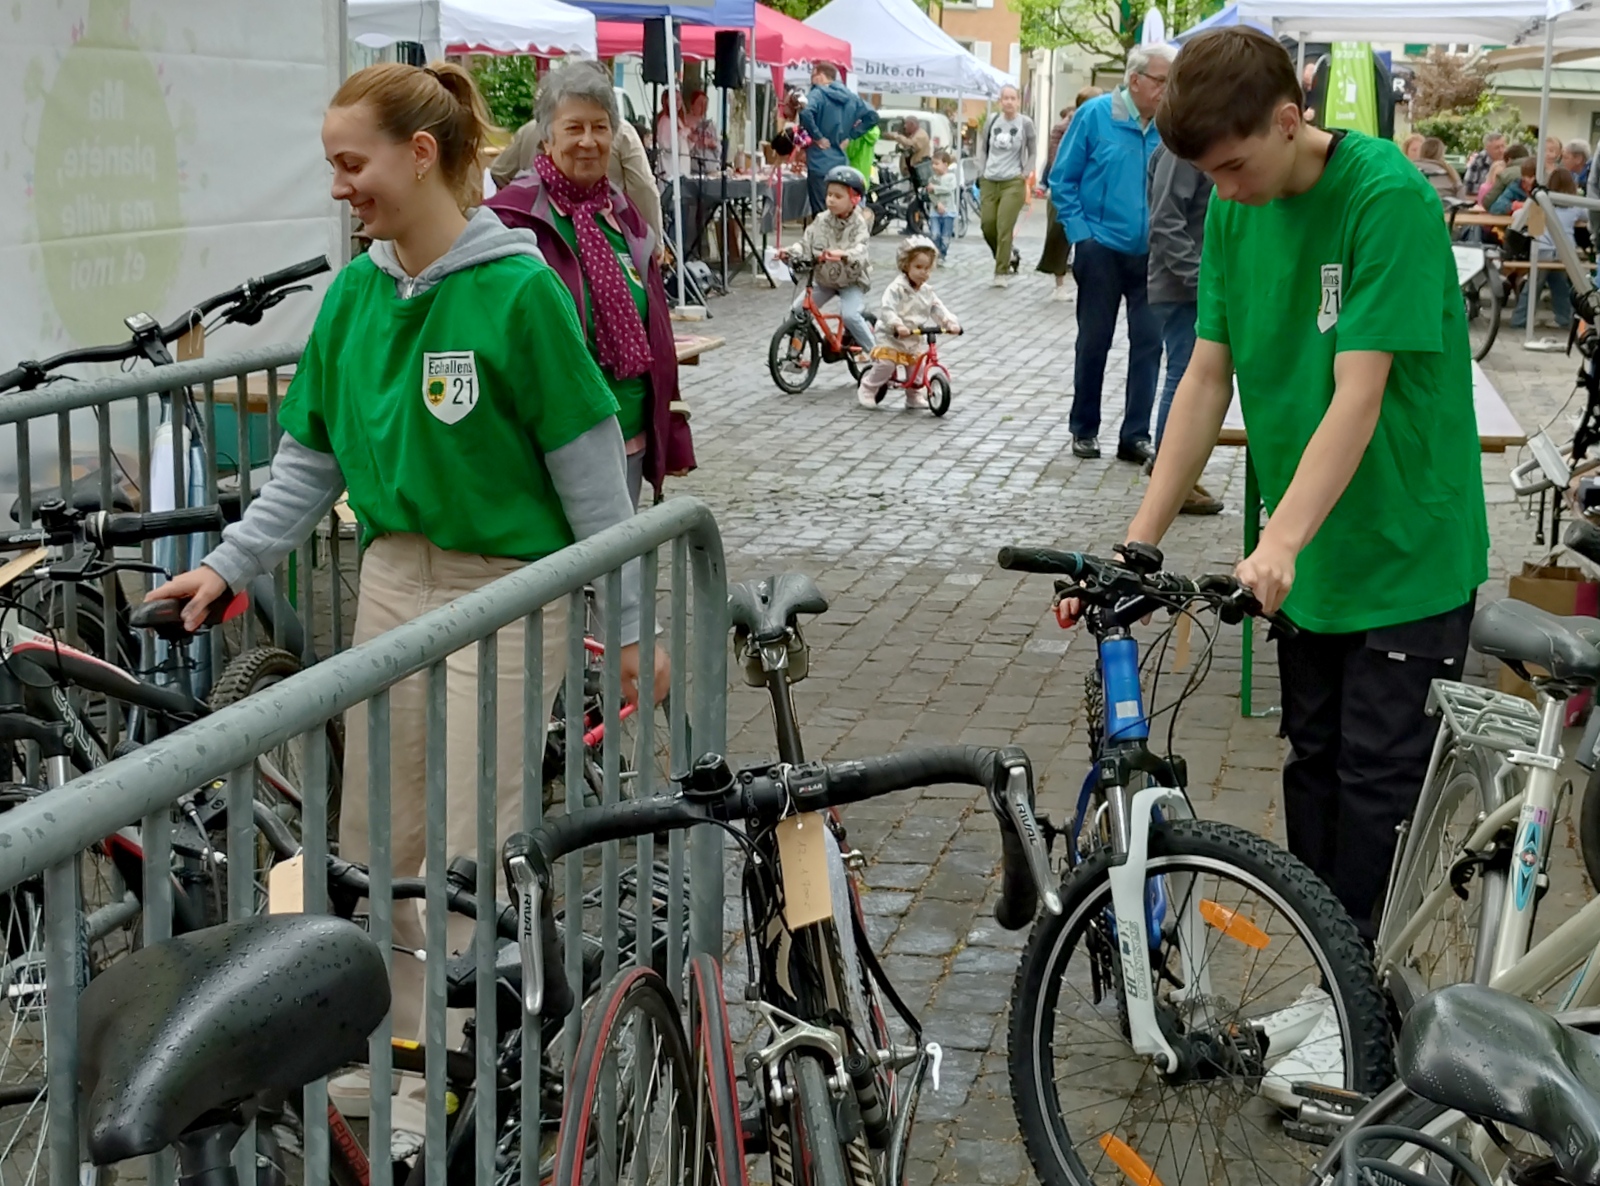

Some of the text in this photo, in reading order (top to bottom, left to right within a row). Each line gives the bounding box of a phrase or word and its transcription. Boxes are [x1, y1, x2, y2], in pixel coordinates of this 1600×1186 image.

[1324, 288, 1340, 315] 21
[428, 359, 473, 376] Echallens
[452, 377, 473, 405] 21
[1016, 803, 1037, 847] RIVAL
[523, 893, 532, 940] RIVAL
